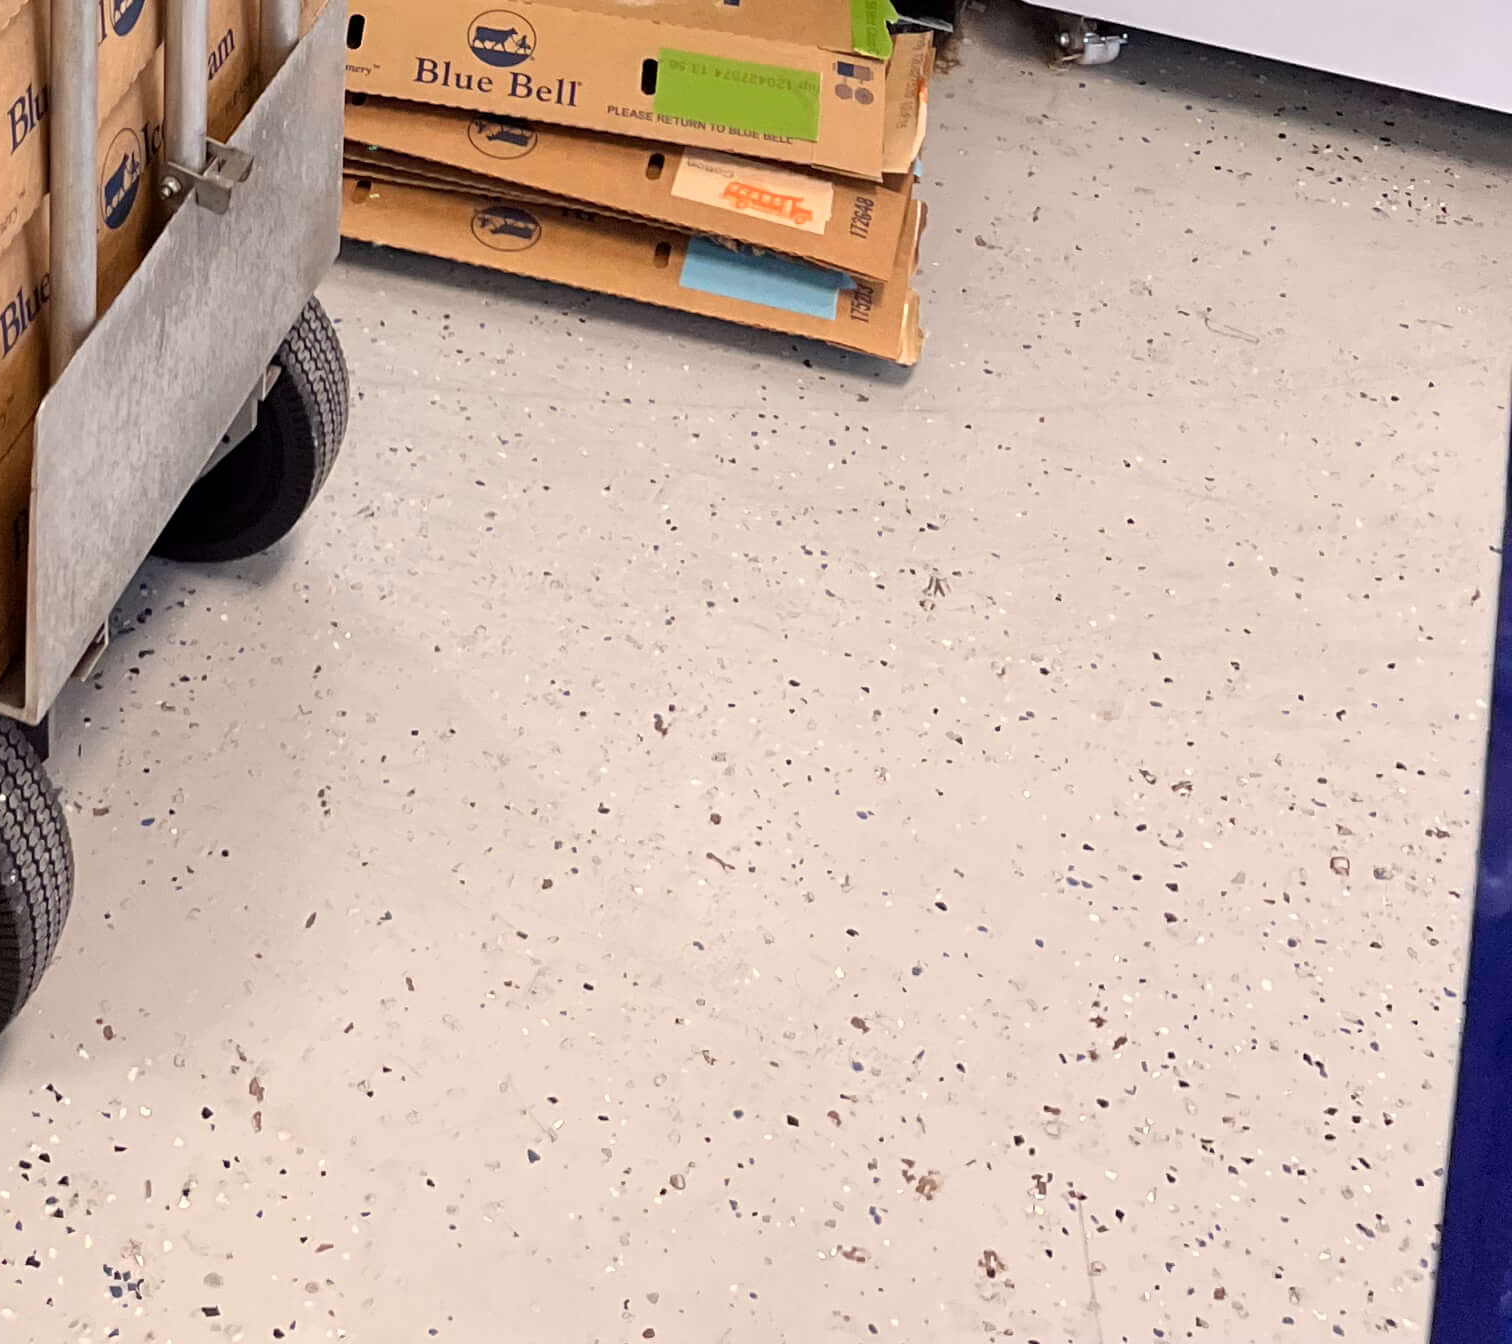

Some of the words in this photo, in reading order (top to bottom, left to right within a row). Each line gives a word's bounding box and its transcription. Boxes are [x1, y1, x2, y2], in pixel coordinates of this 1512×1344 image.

[414, 57, 493, 96] Blue
[508, 72, 579, 108] Bell
[607, 104, 653, 122] PLEASE
[656, 114, 706, 131] RETURN
[710, 122, 726, 134] TO
